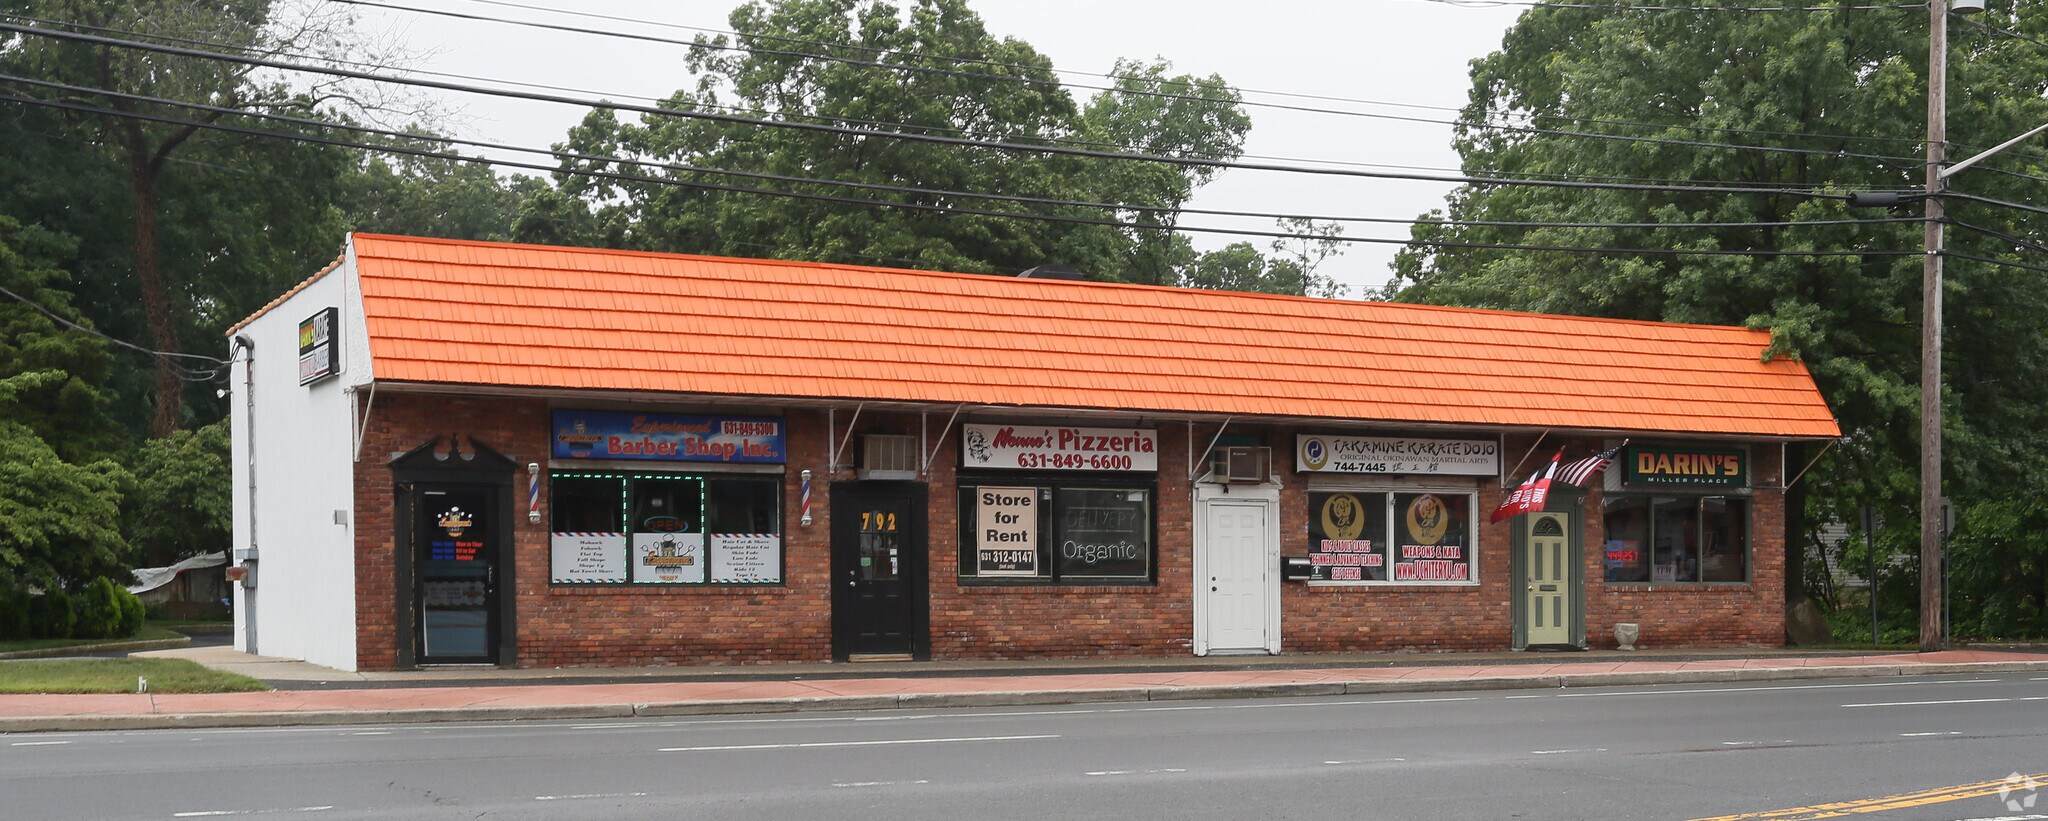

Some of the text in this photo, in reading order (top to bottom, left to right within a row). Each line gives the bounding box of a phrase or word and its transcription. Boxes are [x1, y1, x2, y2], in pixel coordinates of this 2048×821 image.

[608, 436, 779, 461] Barber Shop Inc.
[1058, 429, 1155, 453] Pizzeria
[1333, 439, 1495, 456] TAKAMINE KARATE DOJO
[1017, 452, 1132, 470] 631-849-6600
[1333, 461, 1386, 472] 744-7445
[1340, 453, 1489, 465] ORIGINAL OKINAWAN MARTIAL ARTS
[1638, 453, 1739, 476] DARIN'S
[982, 493, 1031, 507] Store
[1531, 488, 1546, 504] THIS
[862, 512, 896, 531] 792
[994, 511, 1019, 524] for
[647, 520, 683, 531] OPEN
[986, 529, 1028, 542] Rent
[992, 551, 1032, 563] 312-0147
[1063, 540, 1137, 564] Organic
[1402, 545, 1460, 558] WEAPONS & KATA
